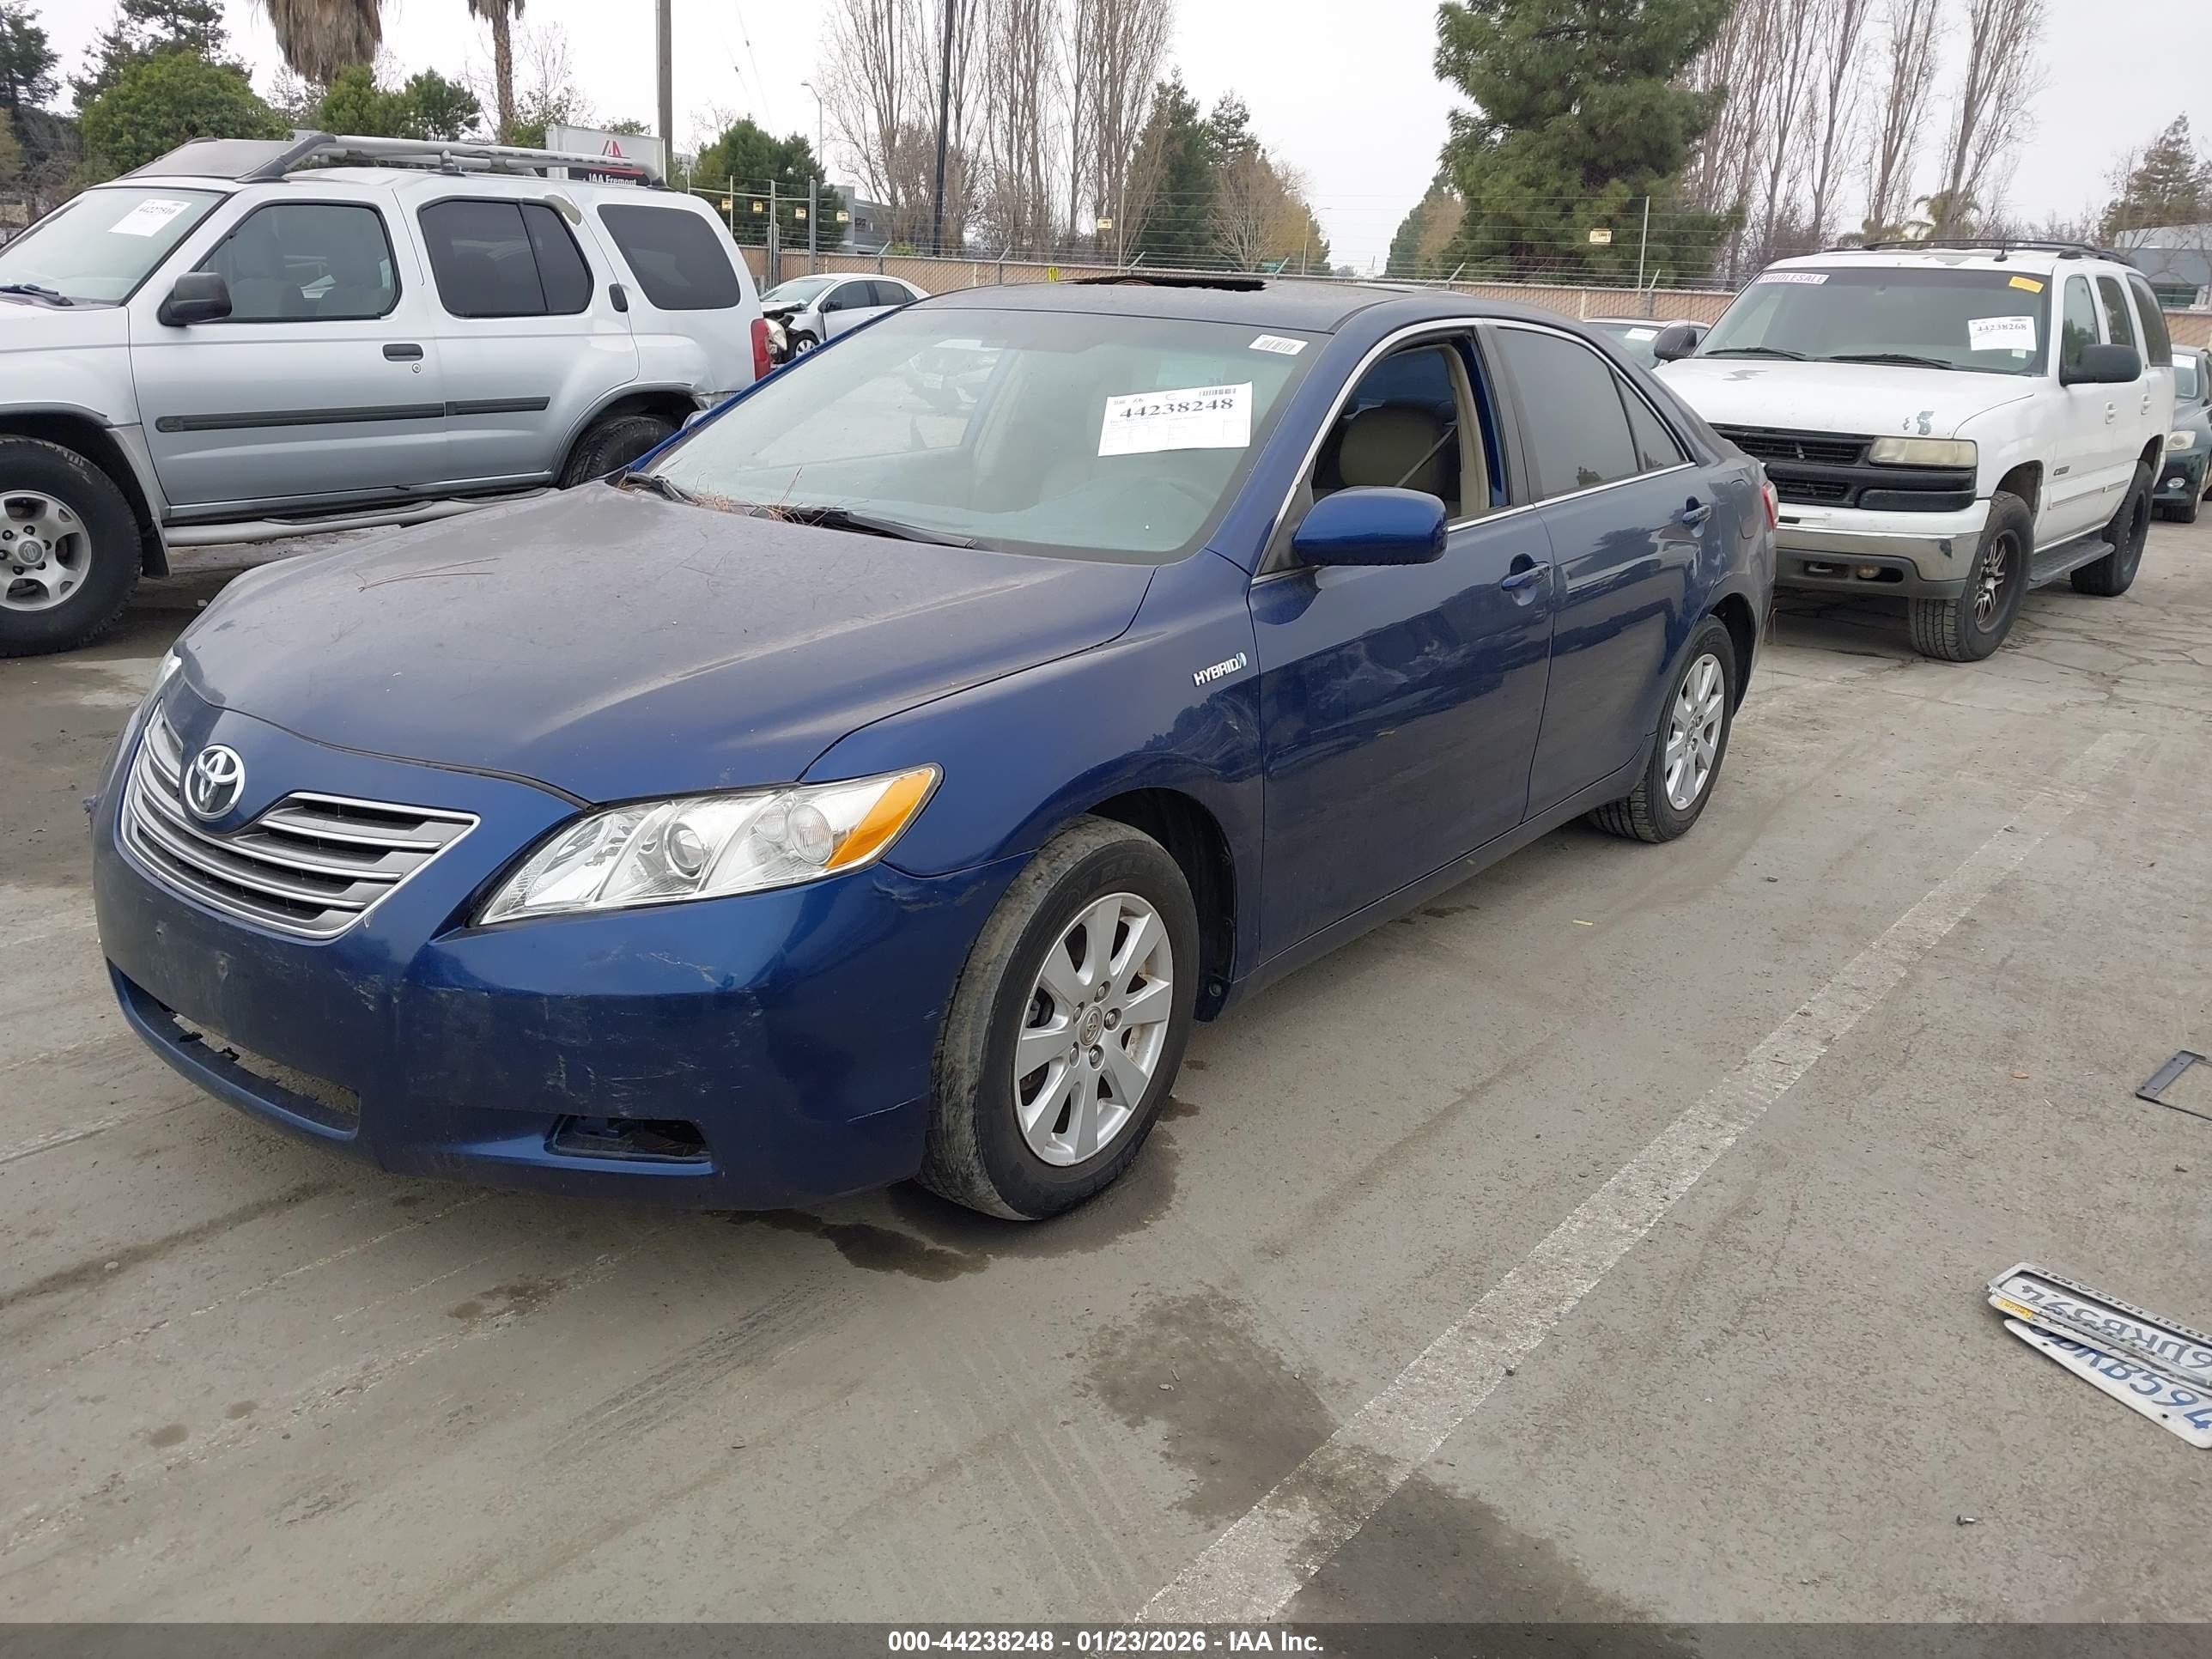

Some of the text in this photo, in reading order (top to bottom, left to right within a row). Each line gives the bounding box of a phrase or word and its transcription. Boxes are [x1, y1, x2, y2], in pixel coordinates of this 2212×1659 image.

[605, 174, 637, 185] Fremont
[1049, 267, 1057, 282] 10
[1759, 274, 1826, 283] WHOLESALE
[1978, 323, 2027, 331] 44238268
[1119, 398, 1234, 418] 44238248
[1193, 658, 1242, 687] HYBRID
